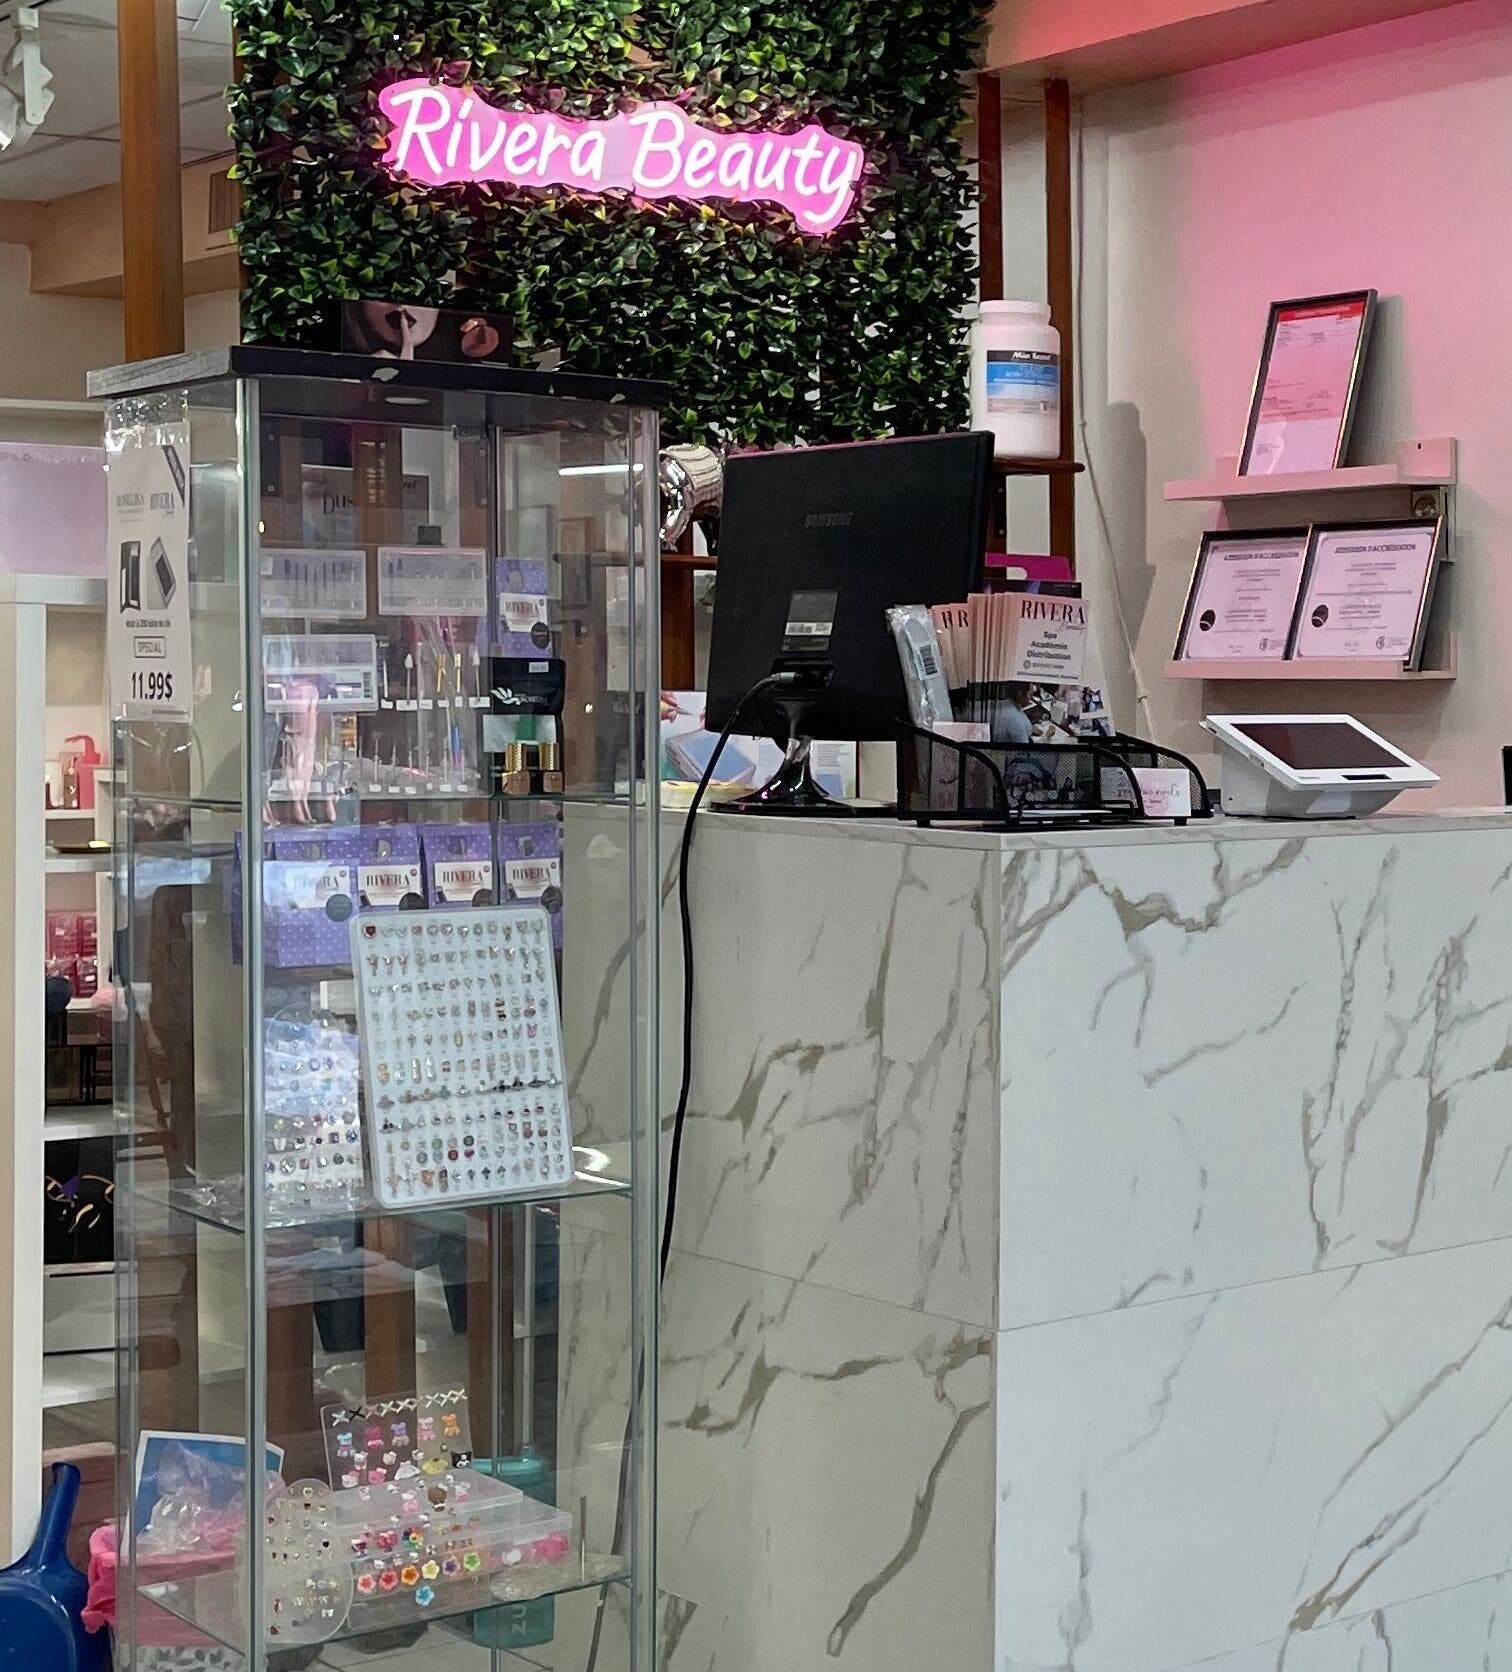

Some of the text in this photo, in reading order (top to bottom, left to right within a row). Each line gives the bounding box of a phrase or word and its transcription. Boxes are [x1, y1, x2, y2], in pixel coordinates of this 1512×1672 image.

[390, 88, 858, 224] Rivera Beauty
[1020, 600, 1085, 624] RIVERA
[131, 671, 173, 701] 11.99$
